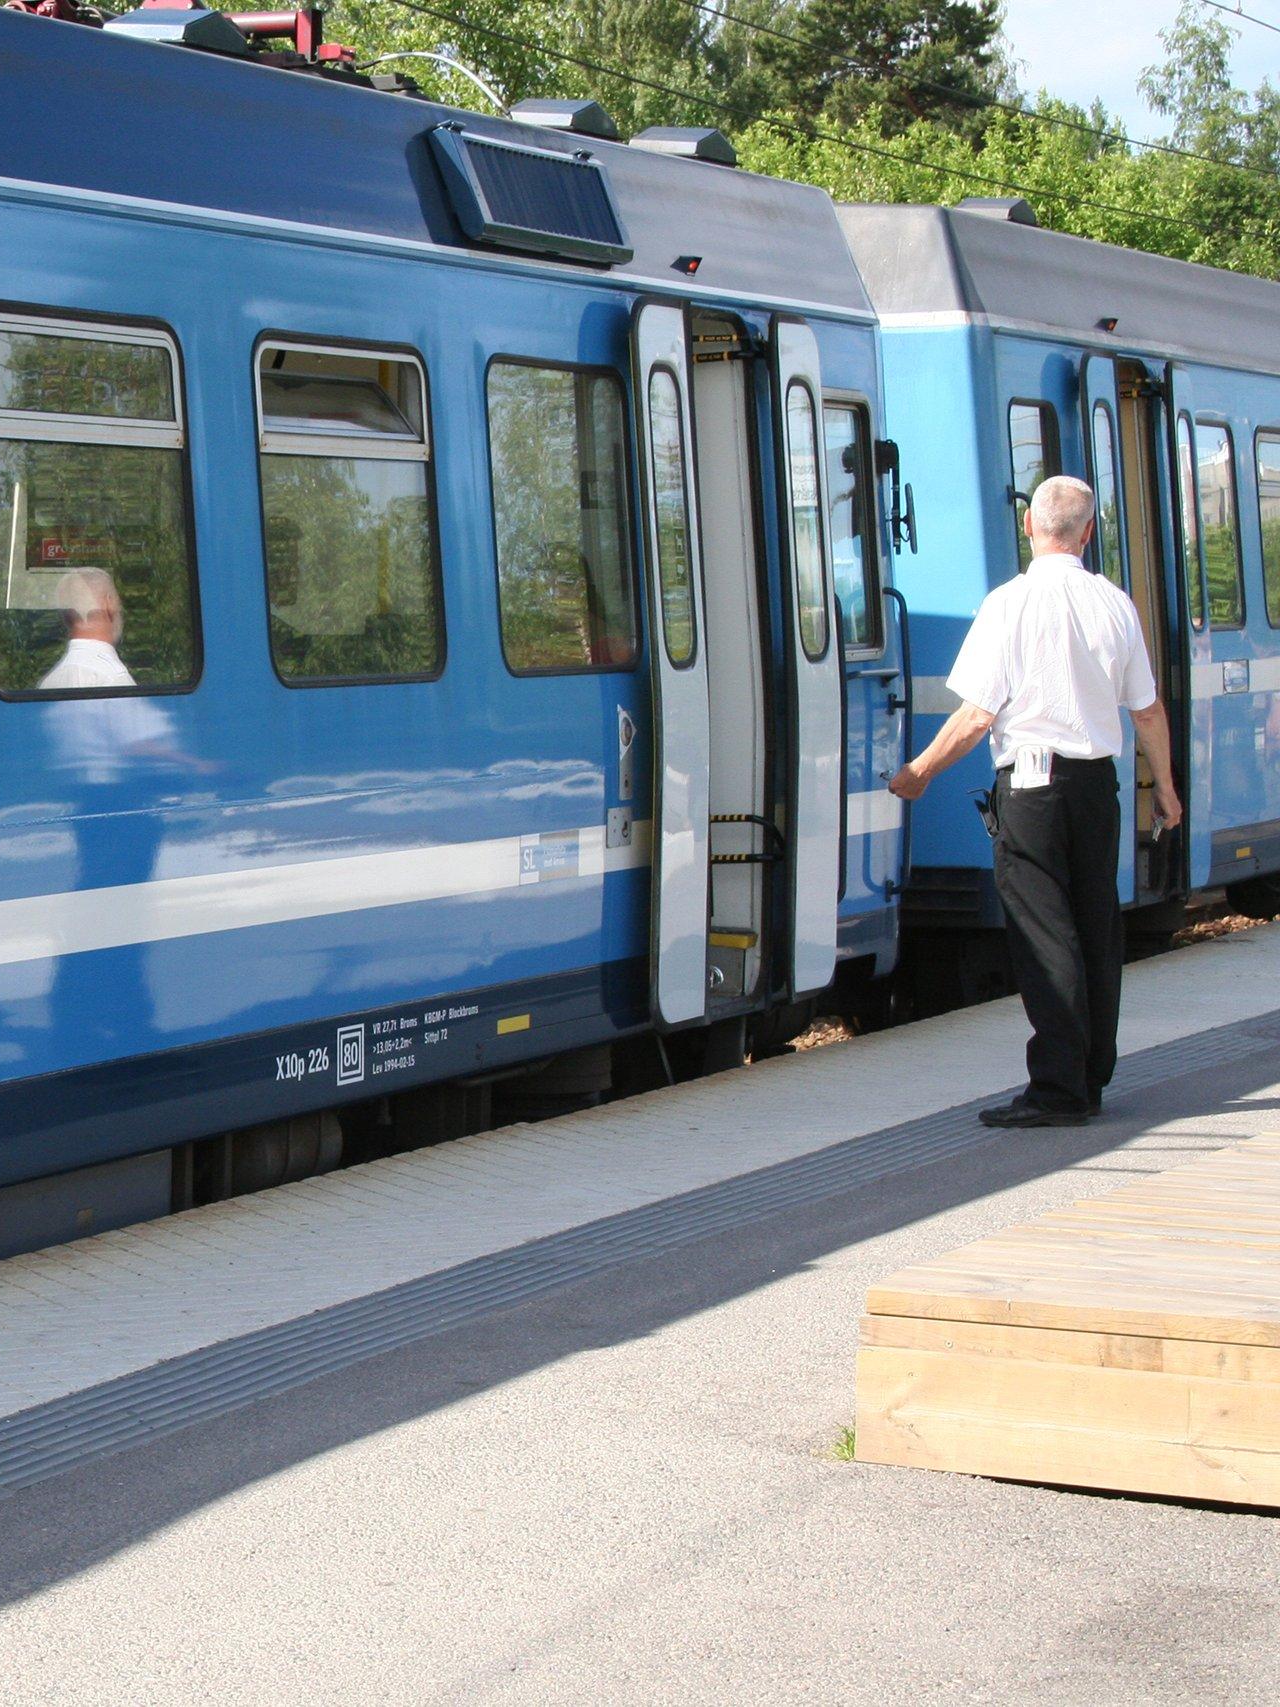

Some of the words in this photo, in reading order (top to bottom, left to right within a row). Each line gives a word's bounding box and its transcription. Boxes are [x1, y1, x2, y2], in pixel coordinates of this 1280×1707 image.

[523, 848, 536, 870] SL
[372, 1023, 381, 1034] VR
[440, 1028, 448, 1040] 72
[276, 1053, 305, 1081] X10p
[308, 1046, 329, 1073] 226
[344, 1042, 358, 1067] 80
[372, 1063, 383, 1075] Lev
[384, 1055, 416, 1072] 1994-02-15
